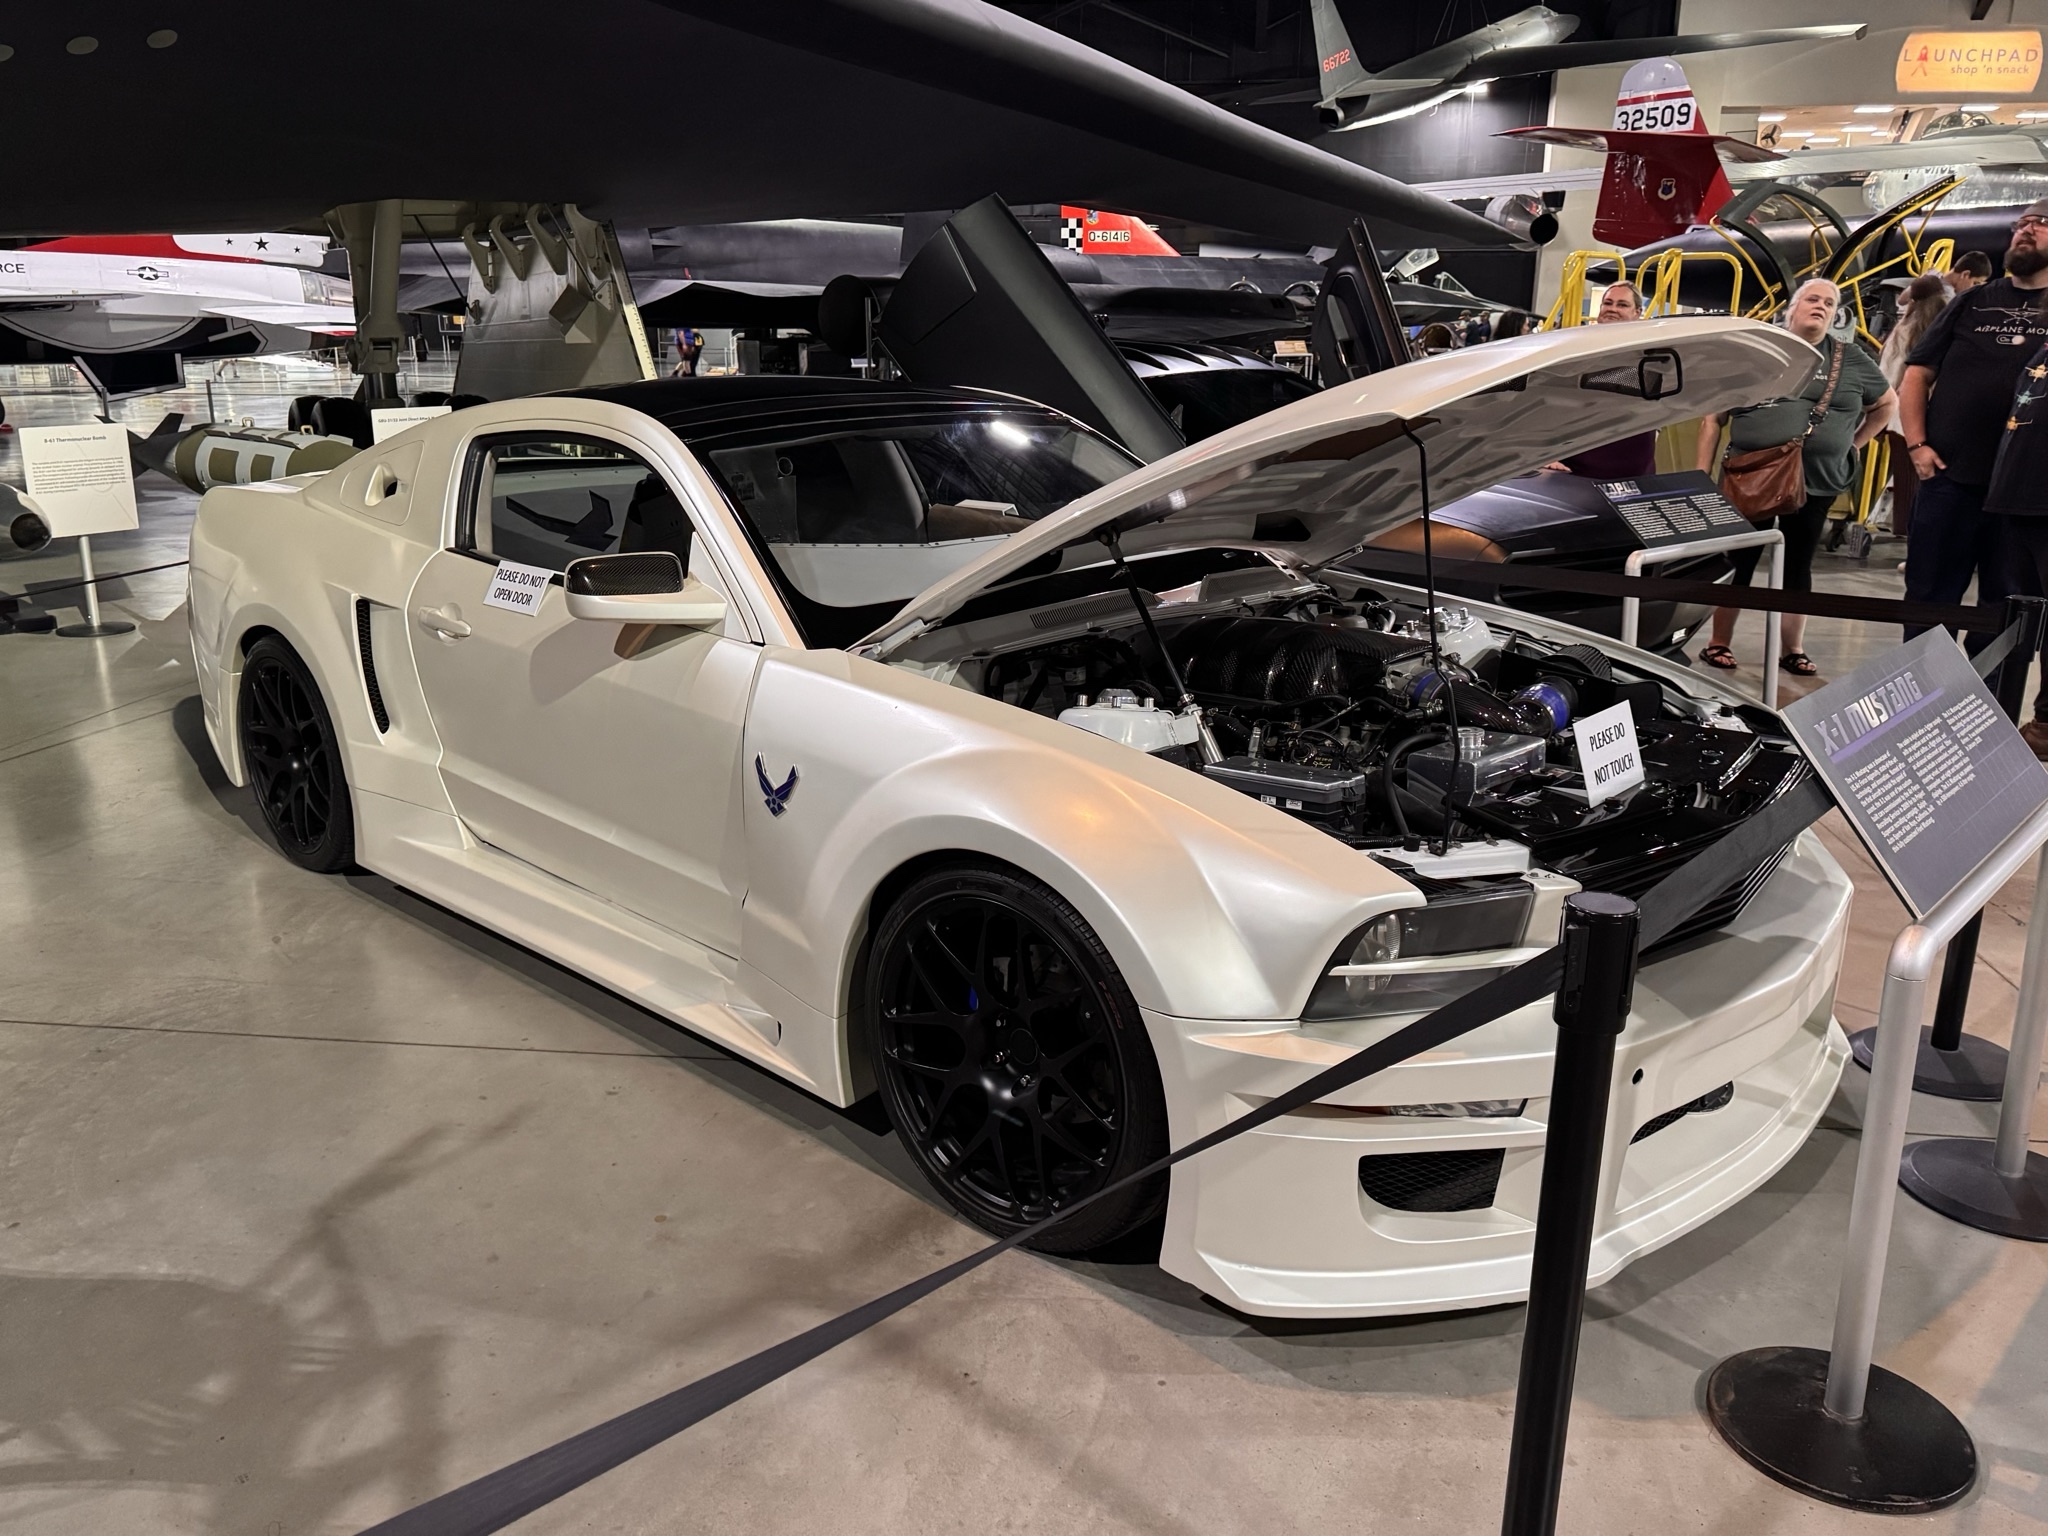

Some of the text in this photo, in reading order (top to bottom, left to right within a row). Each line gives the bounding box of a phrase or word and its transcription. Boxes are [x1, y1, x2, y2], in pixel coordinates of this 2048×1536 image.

[1322, 48, 1351, 72] 66722
[1951, 64, 1978, 76] shop
[1998, 64, 2029, 74] snack
[1616, 103, 1691, 130] 32509
[1974, 324, 2024, 334] AIRPLANE
[496, 568, 546, 588] PLEASE DO NOT
[493, 588, 532, 606] OPEN DOOR
[1589, 722, 1626, 752] PLEASE DO
[1594, 752, 1635, 786] NOT TOUCH
